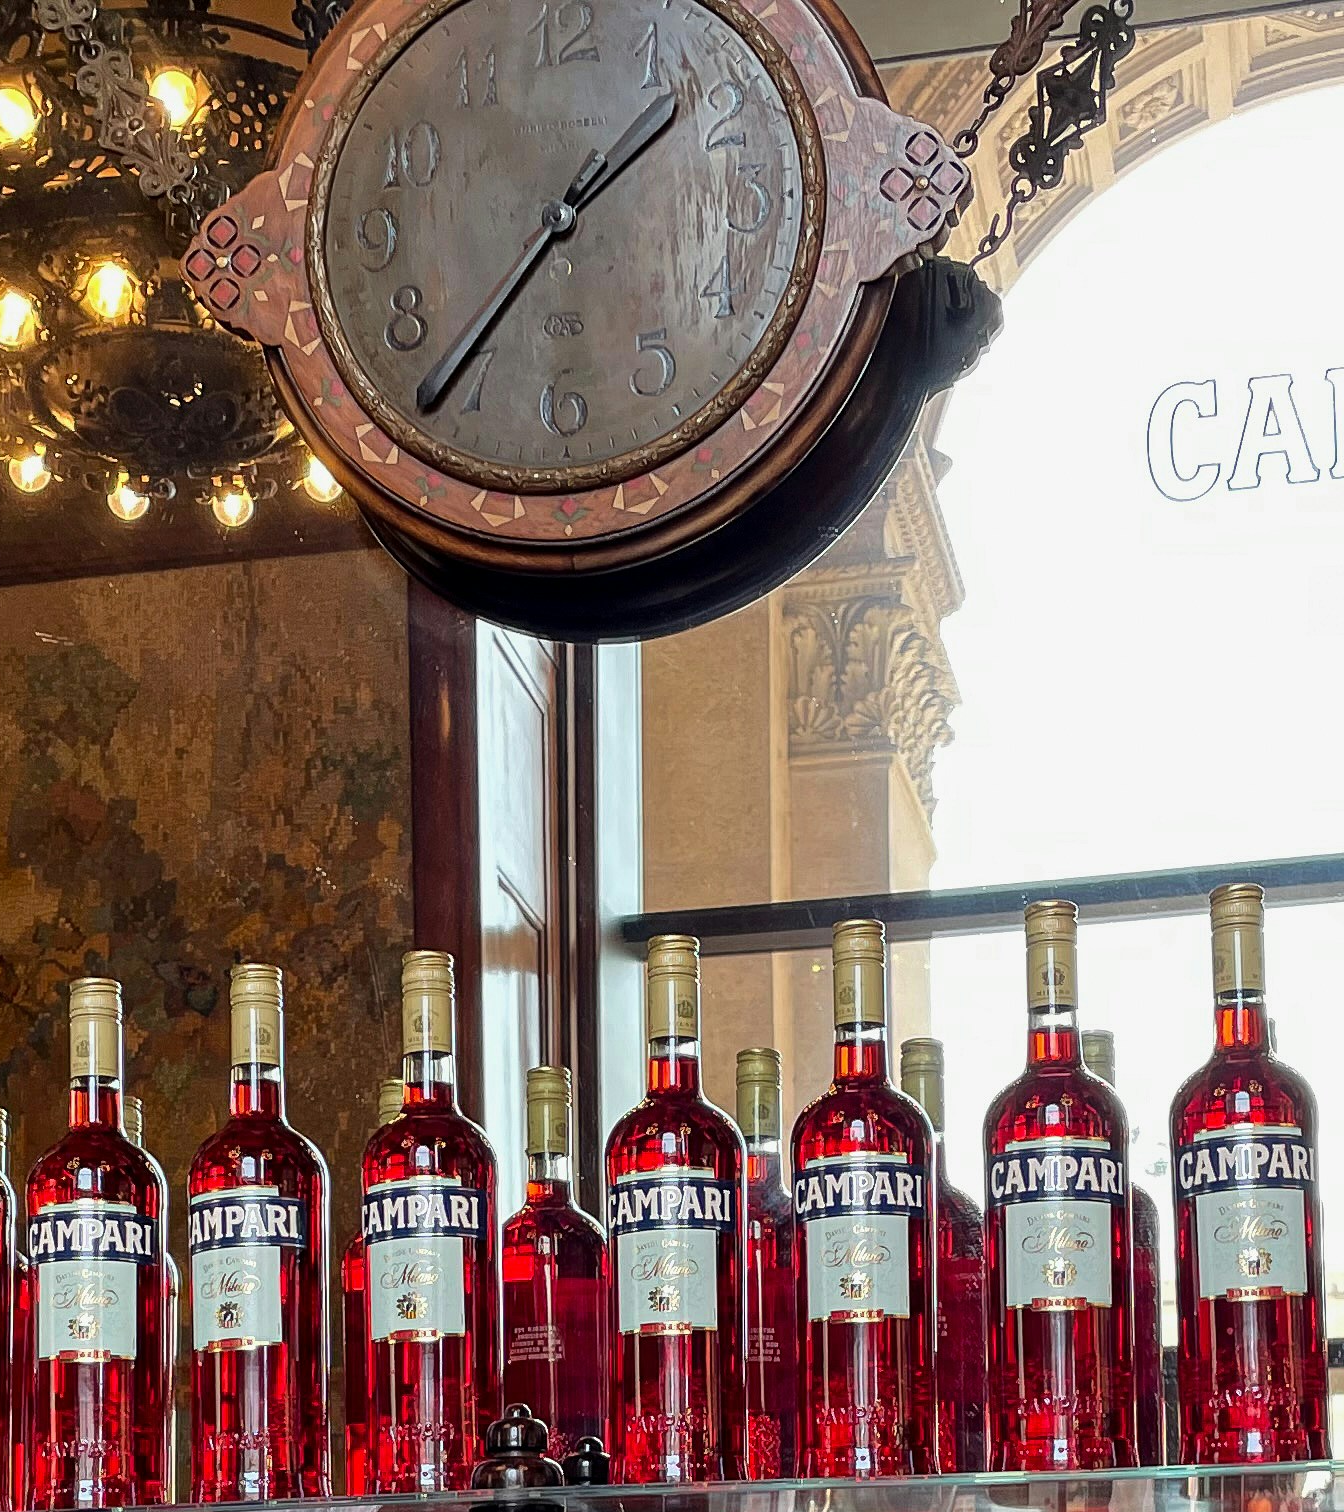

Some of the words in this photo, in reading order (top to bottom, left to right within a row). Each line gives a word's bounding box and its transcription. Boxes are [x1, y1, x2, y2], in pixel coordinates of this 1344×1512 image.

[528, 4, 600, 67] 12
[636, 22, 662, 89] 1
[458, 45, 499, 107] 11
[706, 81, 746, 152] 2
[384, 120, 442, 189] 10
[728, 163, 770, 233] 3
[357, 208, 398, 272] 9
[384, 285, 428, 351] 8
[698, 256, 736, 319] 4
[460, 347, 495, 413] 7
[629, 328, 676, 396] 5
[540, 383, 587, 437] 6
[796, 1171, 922, 1214] CAMPARI
[991, 1156, 1124, 1199] CAMPARI
[1179, 1143, 1316, 1190] CAMPARI
[30, 1219, 152, 1257] CAMPARI
[188, 1204, 298, 1244] AMPARI
